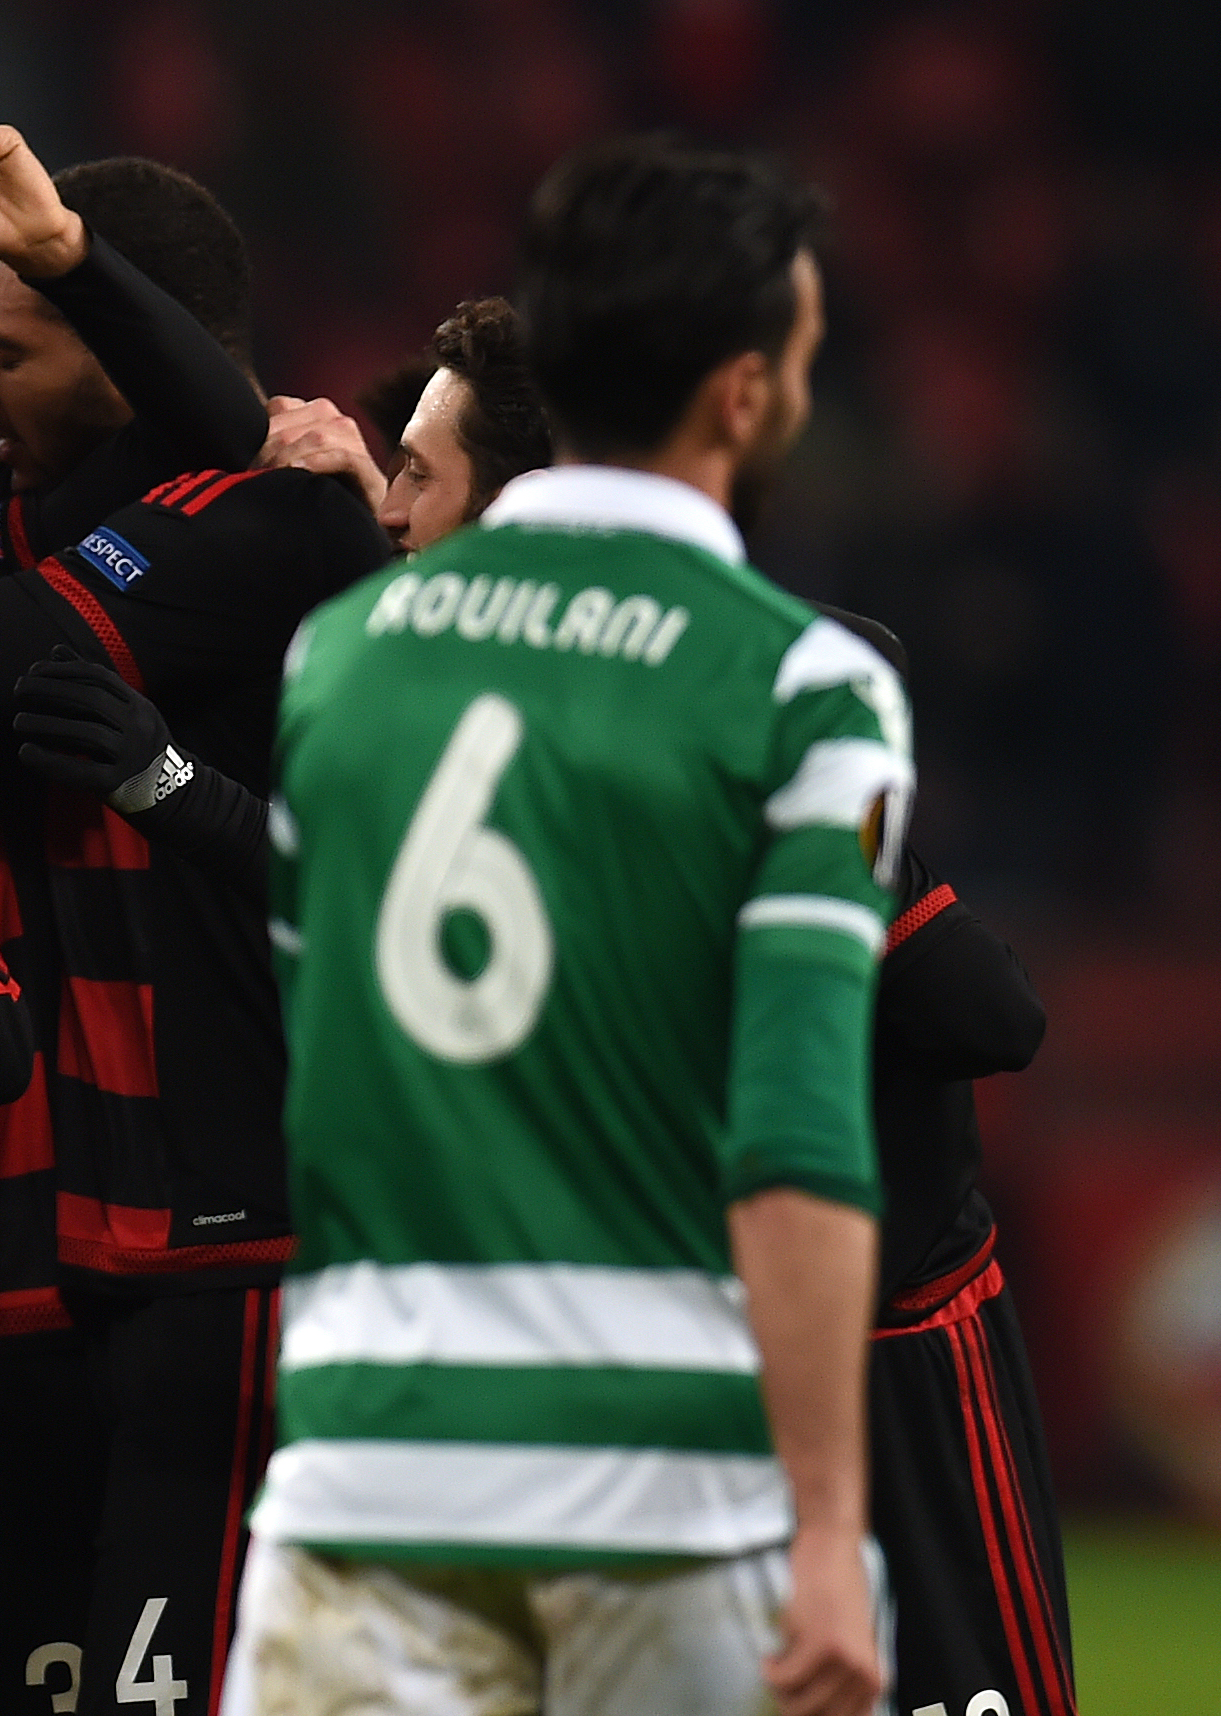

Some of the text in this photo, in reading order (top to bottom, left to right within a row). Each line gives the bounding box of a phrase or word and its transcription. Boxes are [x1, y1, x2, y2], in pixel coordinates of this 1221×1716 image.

[81, 532, 144, 583] ESPECT
[374, 692, 554, 1065] 6
[192, 1208, 246, 1227] climacool
[115, 1596, 188, 1716] 4
